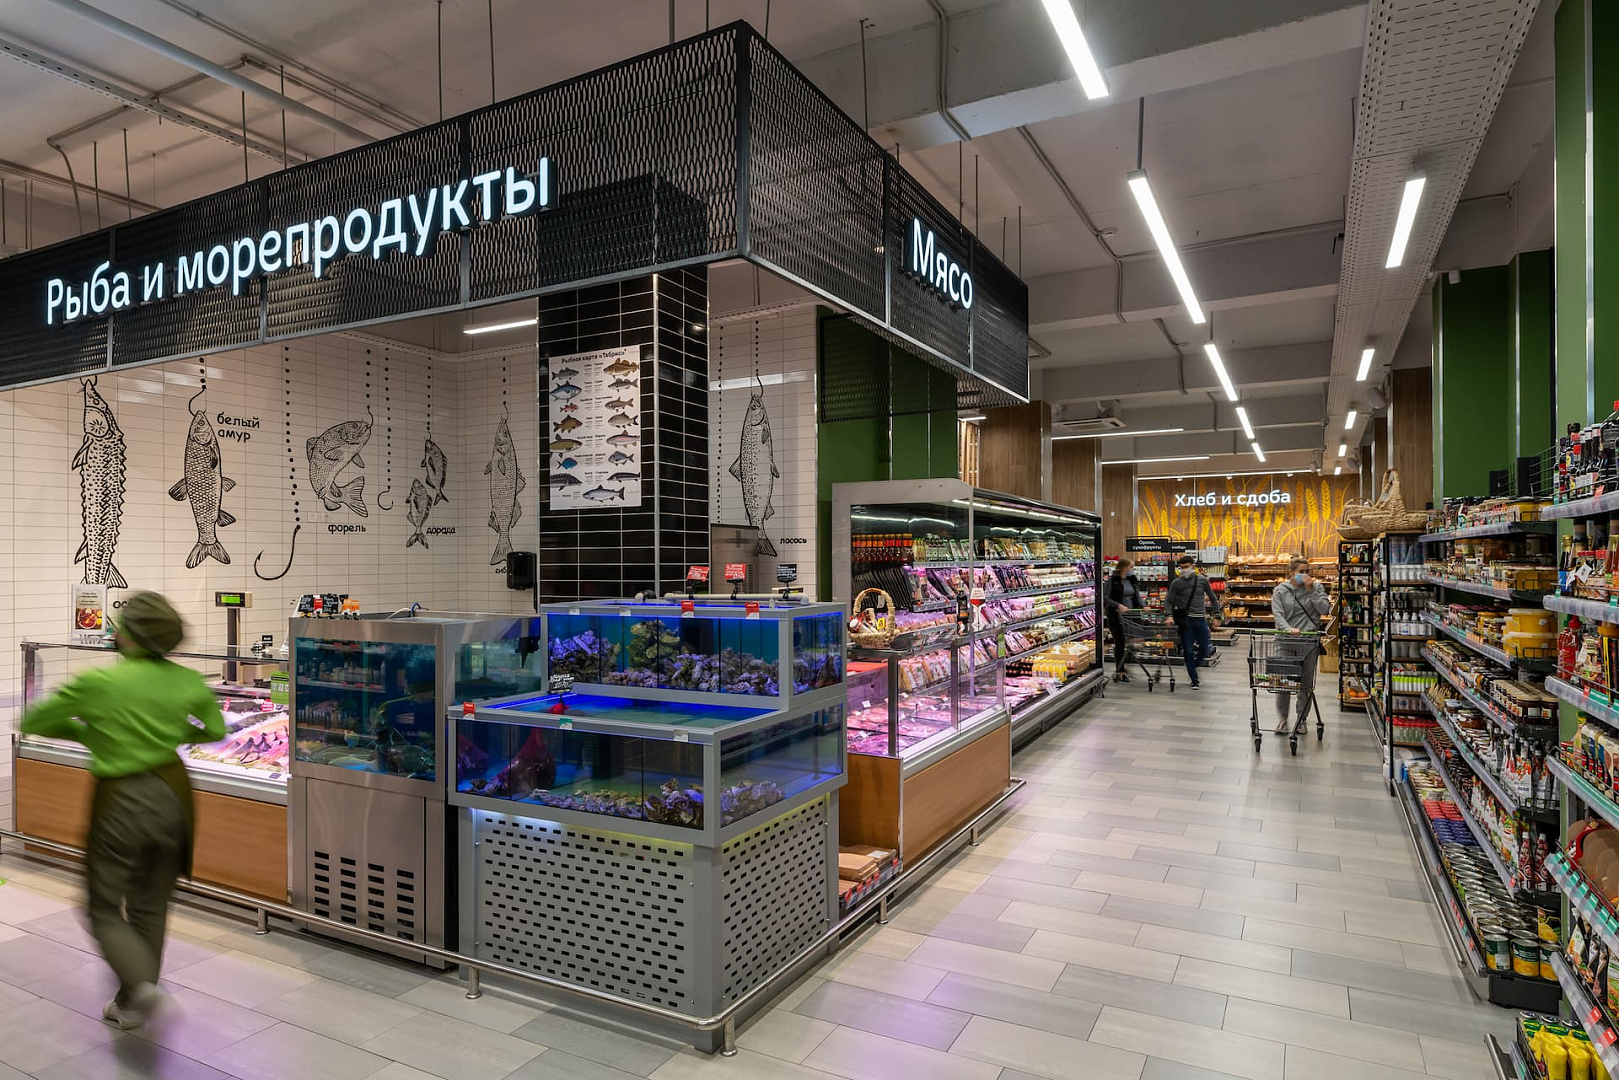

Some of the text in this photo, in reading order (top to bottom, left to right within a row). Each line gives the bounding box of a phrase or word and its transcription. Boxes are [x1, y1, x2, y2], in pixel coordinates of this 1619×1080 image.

[47, 156, 550, 325] Рыба и морепродукты
[912, 217, 973, 309] Мясо
[216, 412, 261, 429] белый
[217, 429, 251, 443] амур
[1174, 489, 1291, 507] Хлеб и сдоба
[327, 524, 367, 535] форель
